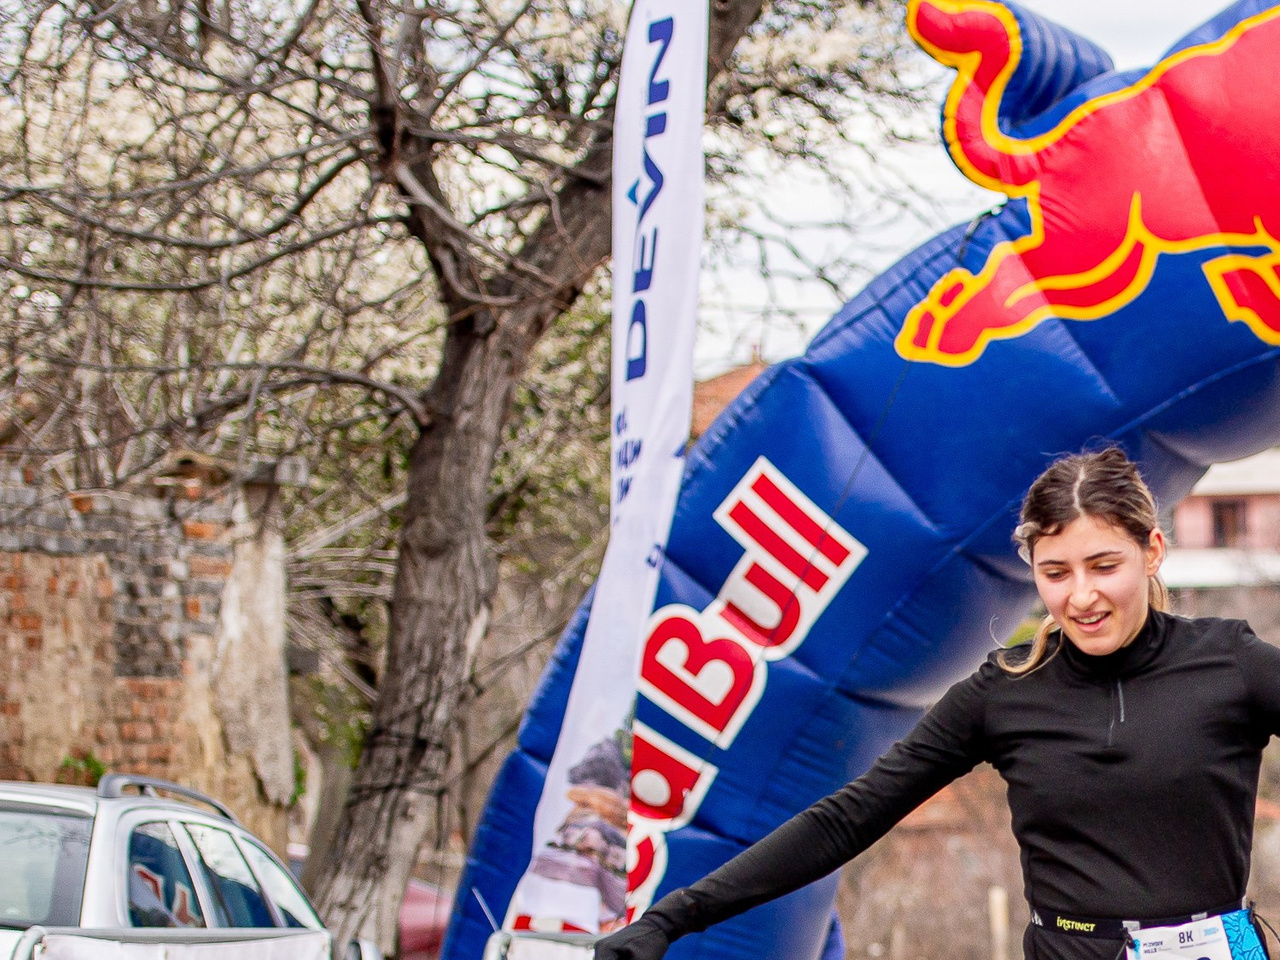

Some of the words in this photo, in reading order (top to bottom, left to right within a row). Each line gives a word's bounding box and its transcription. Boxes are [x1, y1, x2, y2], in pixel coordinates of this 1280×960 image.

[625, 16, 674, 382] DEVIN
[641, 472, 852, 733] Bull
[1178, 930, 1194, 944] 8K
